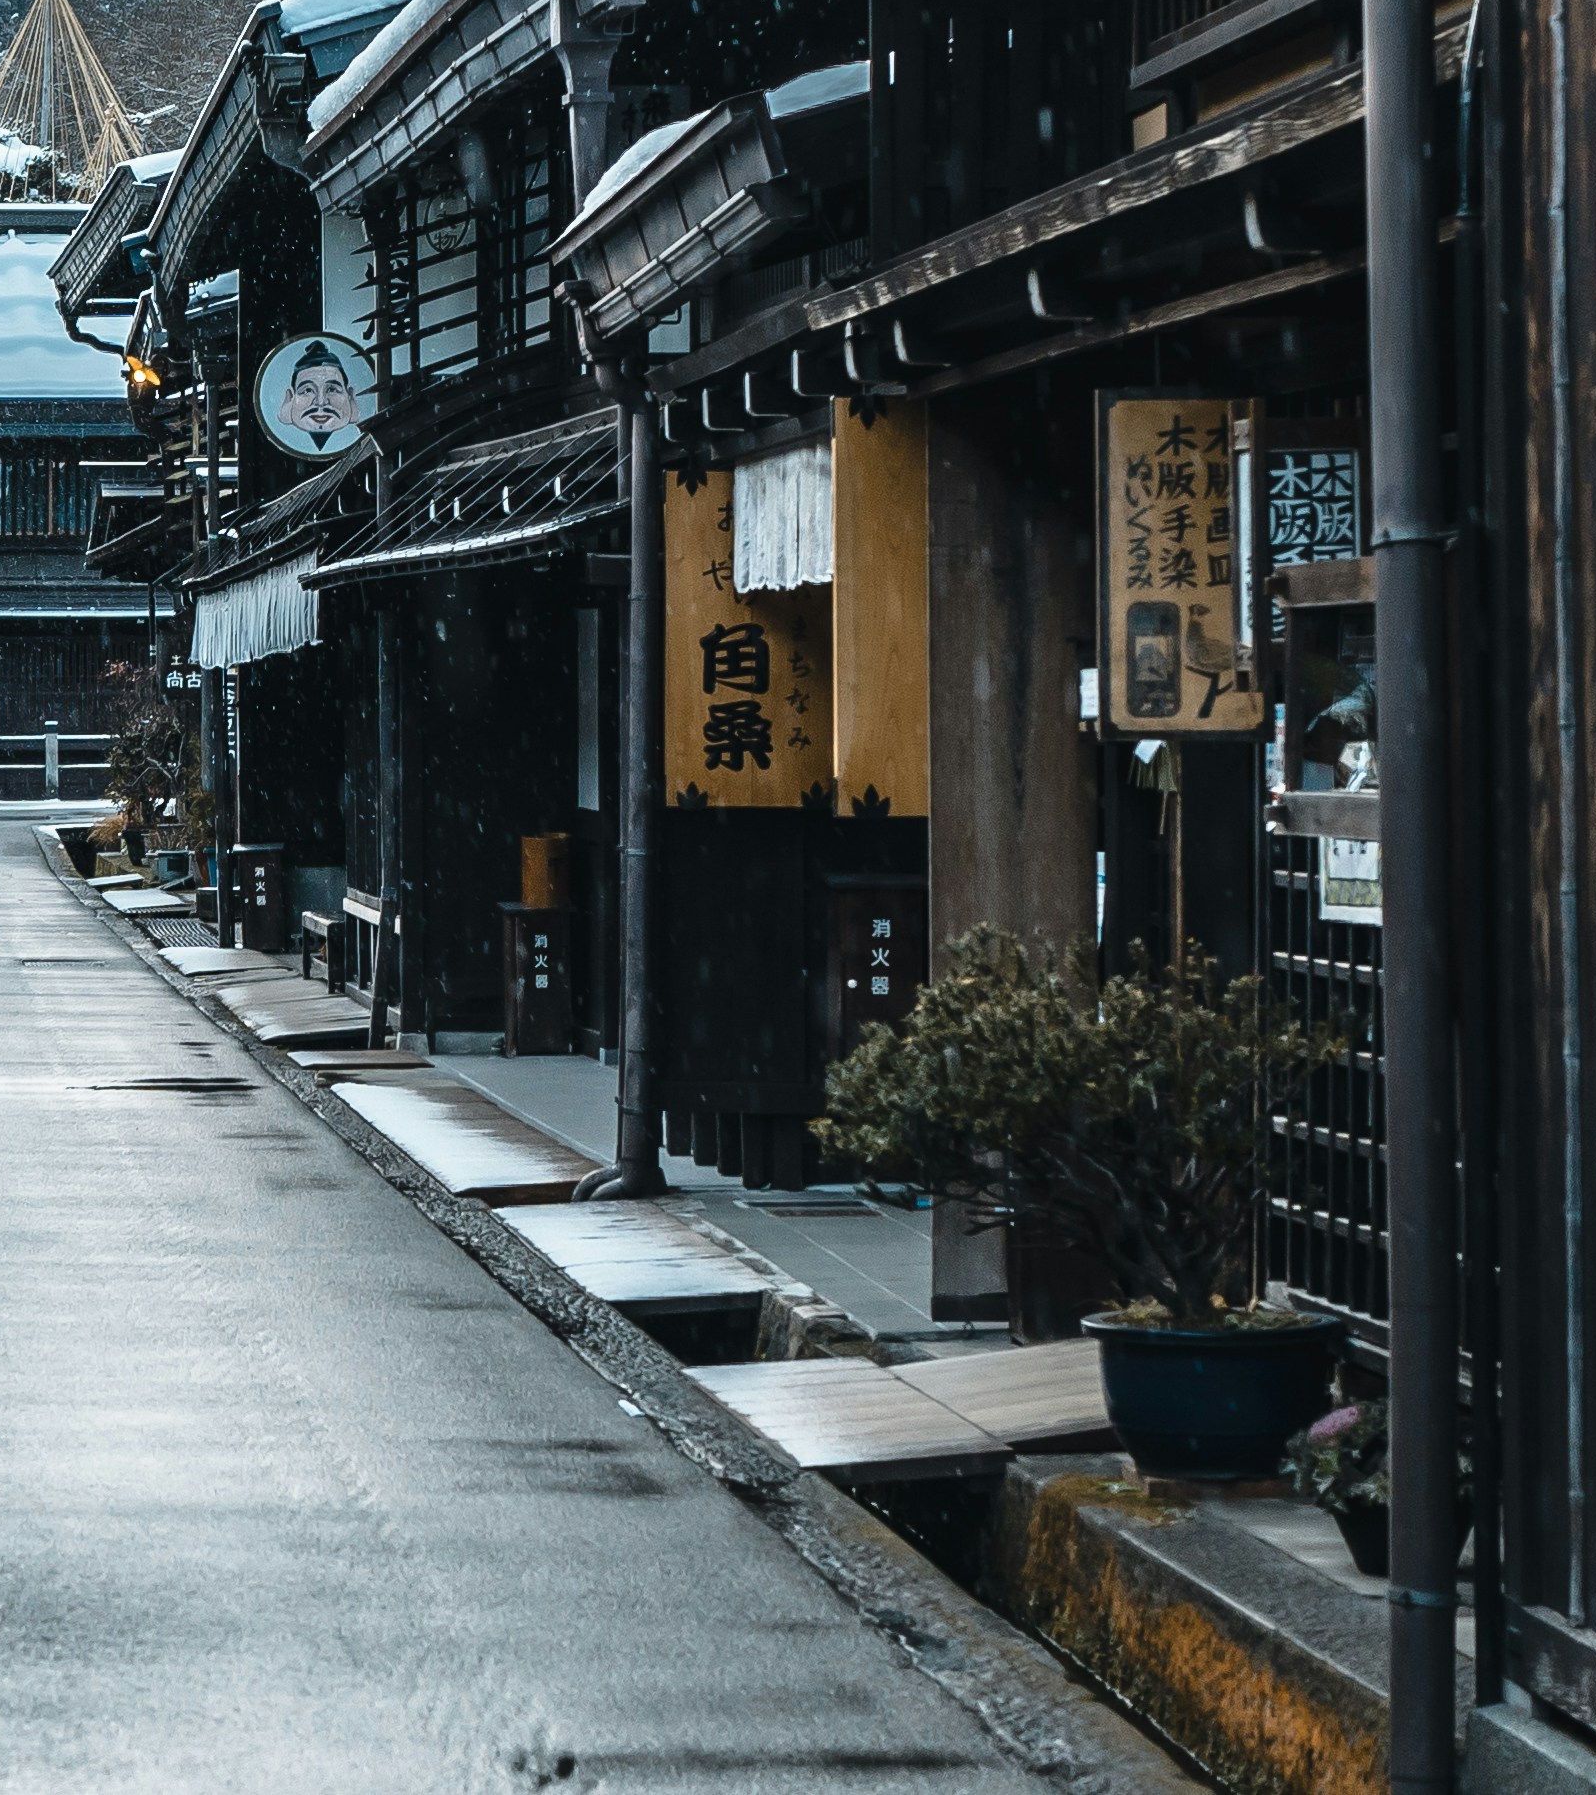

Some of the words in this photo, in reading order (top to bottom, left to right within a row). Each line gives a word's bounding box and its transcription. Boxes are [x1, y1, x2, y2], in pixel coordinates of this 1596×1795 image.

[1155, 414, 1198, 590] 木版手染
[699, 622, 774, 772] 角桑
[534, 934, 549, 989] 消火器
[870, 918, 891, 995] 消火器
